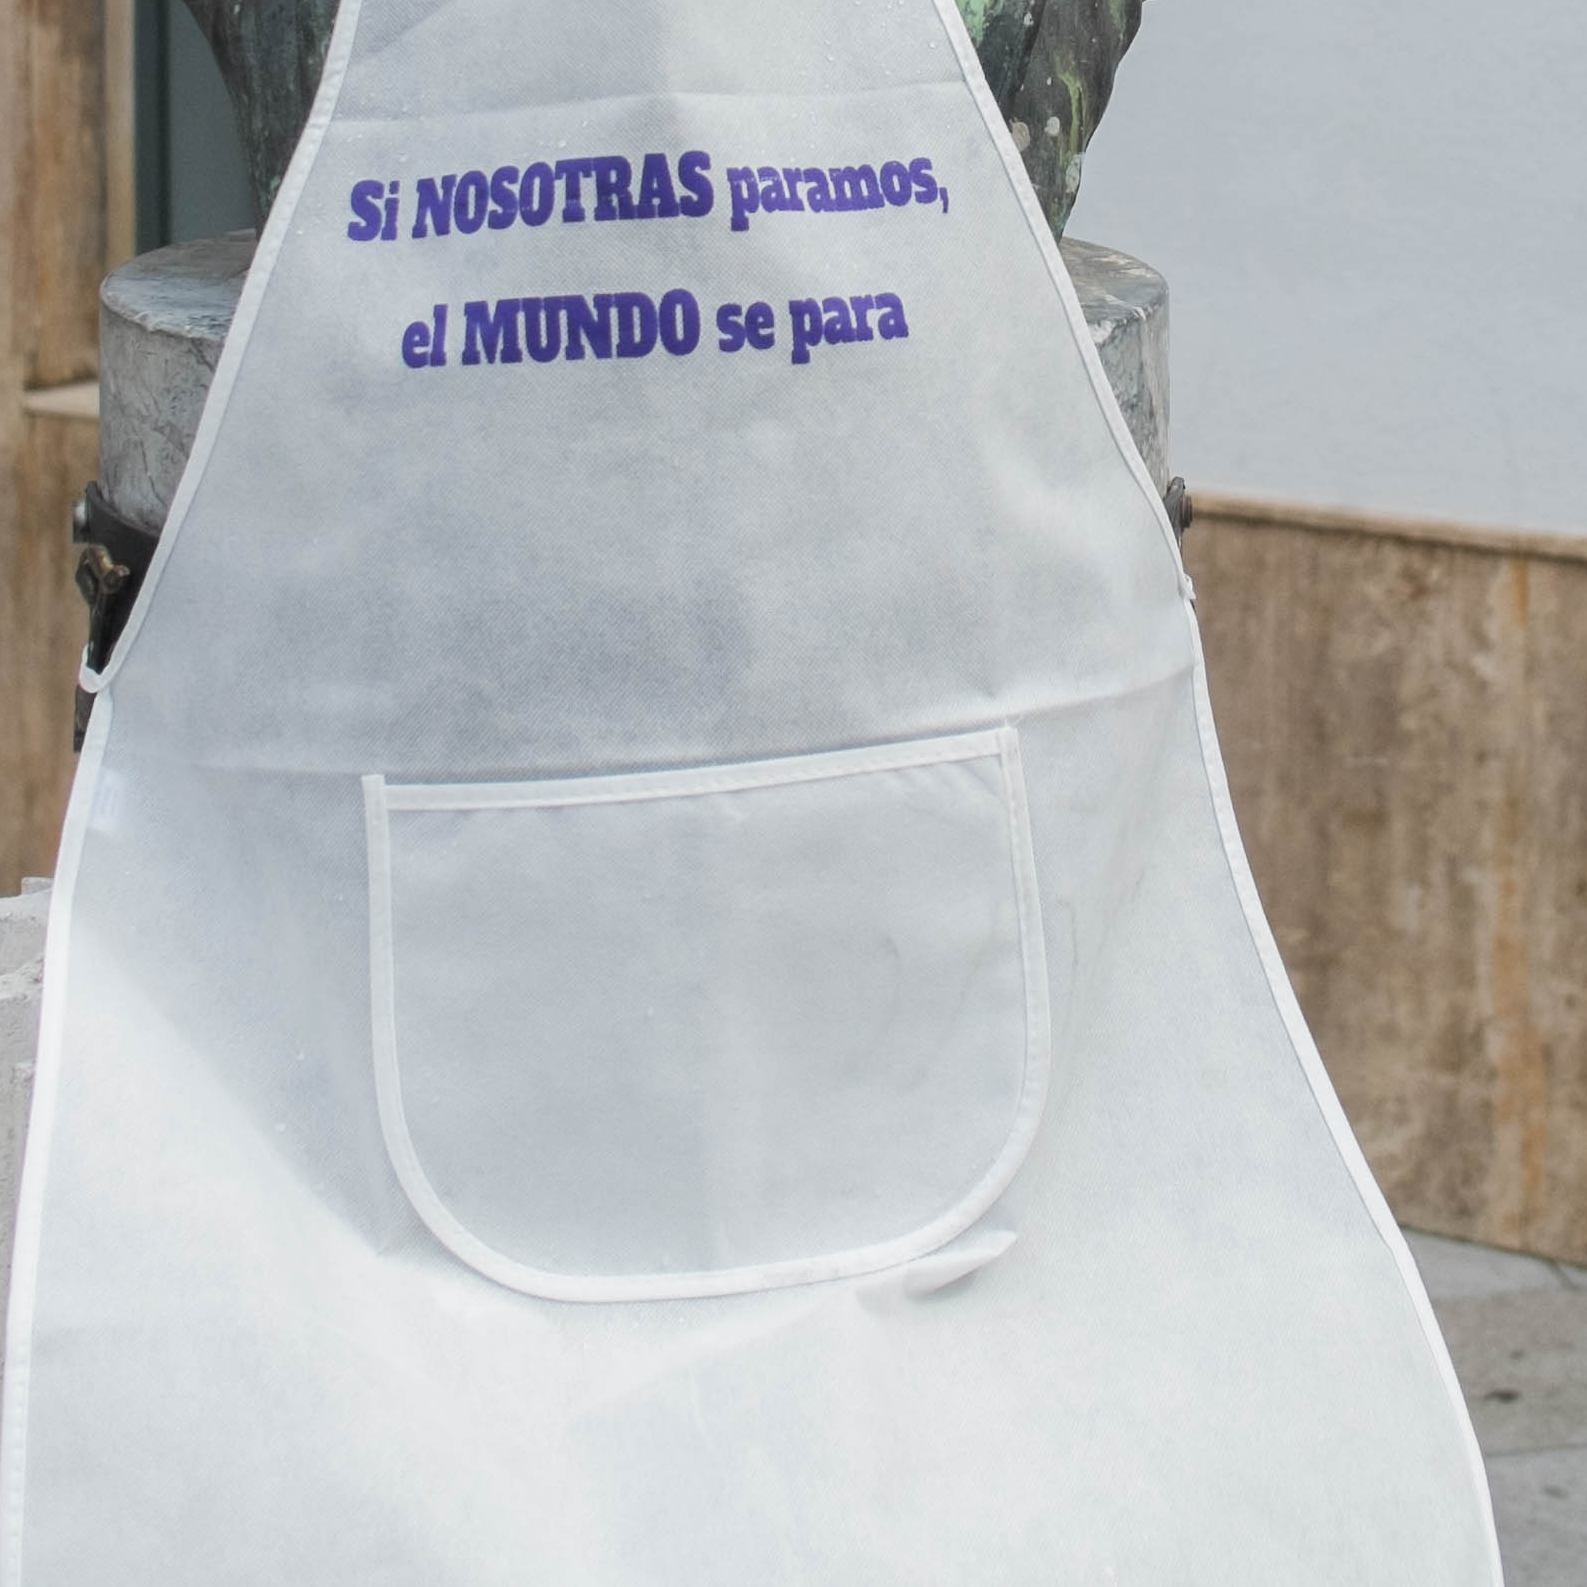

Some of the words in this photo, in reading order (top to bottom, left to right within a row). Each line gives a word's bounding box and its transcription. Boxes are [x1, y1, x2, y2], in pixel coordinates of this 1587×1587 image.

[346, 179, 400, 242] Si
[411, 150, 714, 239] NOSOTRAS
[726, 157, 950, 233] paramos,
[401, 303, 448, 369] el
[461, 288, 701, 366] MUNDO
[716, 300, 775, 353] se
[789, 291, 910, 365] para
